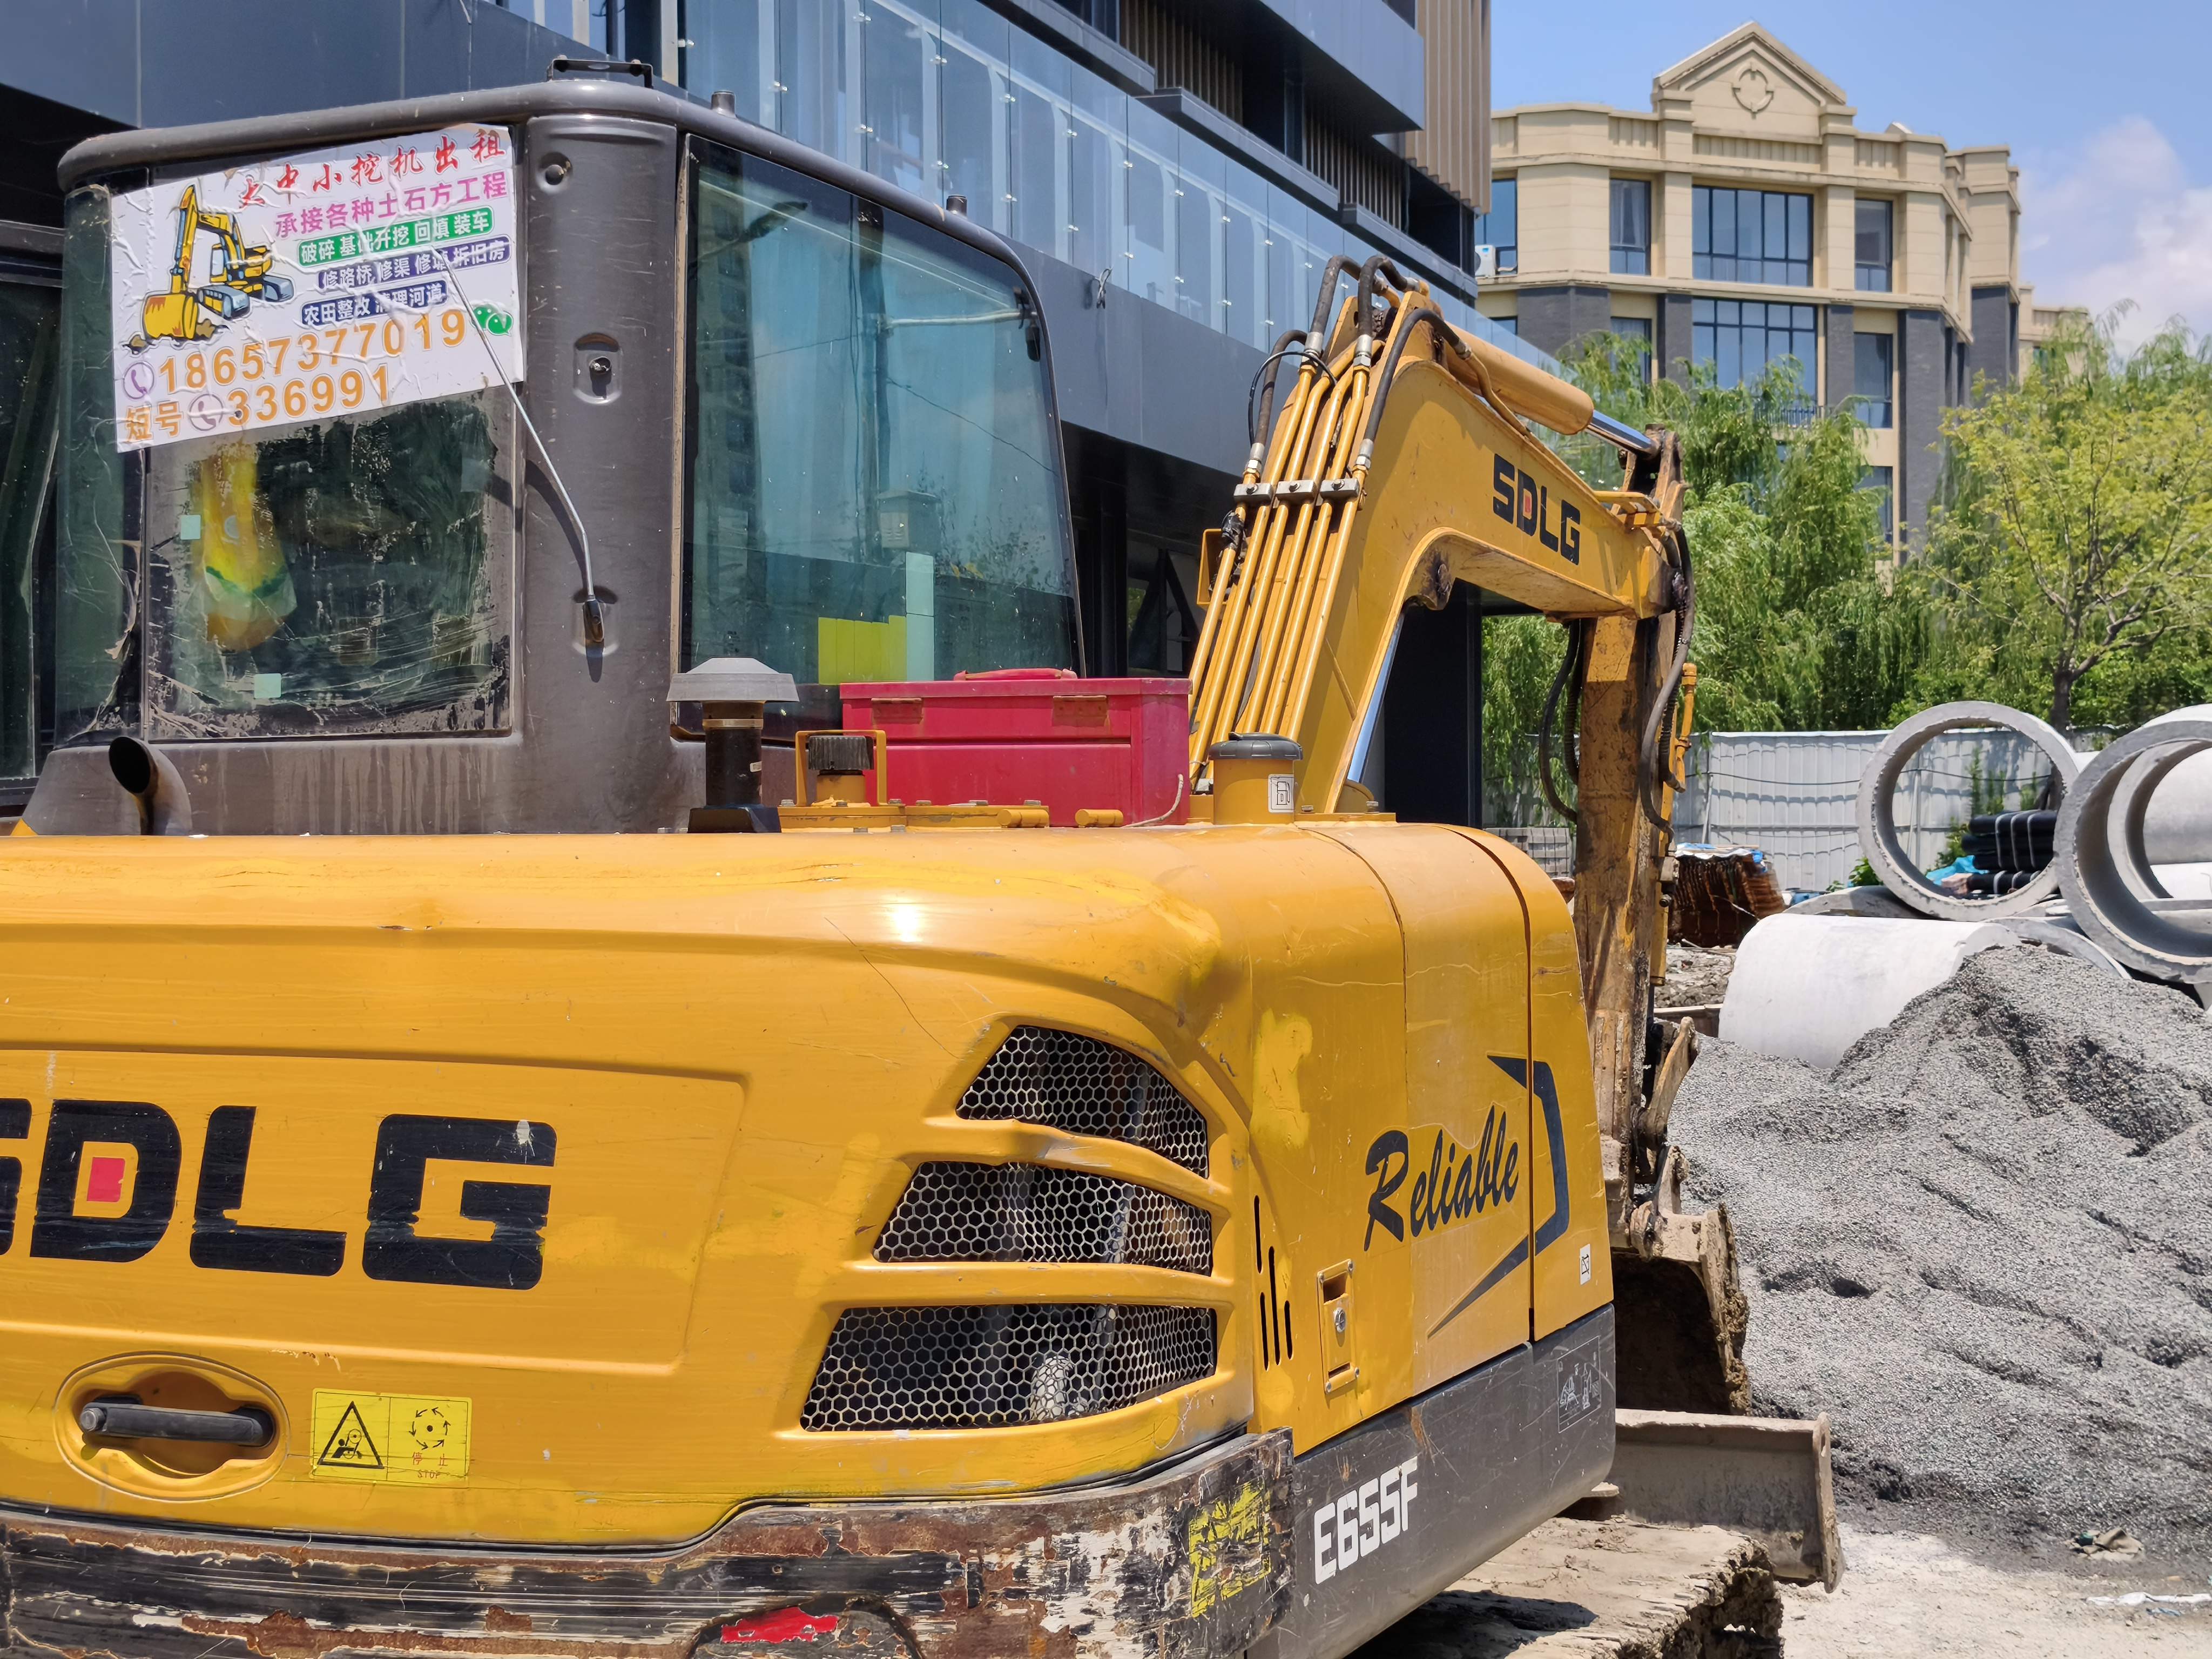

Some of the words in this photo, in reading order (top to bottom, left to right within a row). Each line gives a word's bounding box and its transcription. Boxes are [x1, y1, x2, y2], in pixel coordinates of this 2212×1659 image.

[276, 171, 507, 238] 承接各种土石方工程
[160, 309, 465, 393] 18657377019
[125, 401, 182, 442] 短号
[228, 365, 388, 426] 336991
[1493, 453, 1580, 565] SDLG
[0, 1098, 557, 1290] DLG
[1363, 1104, 1519, 1252] Reliable
[418, 1470, 440, 1479] STOP
[1314, 1455, 1418, 1584] E655F
